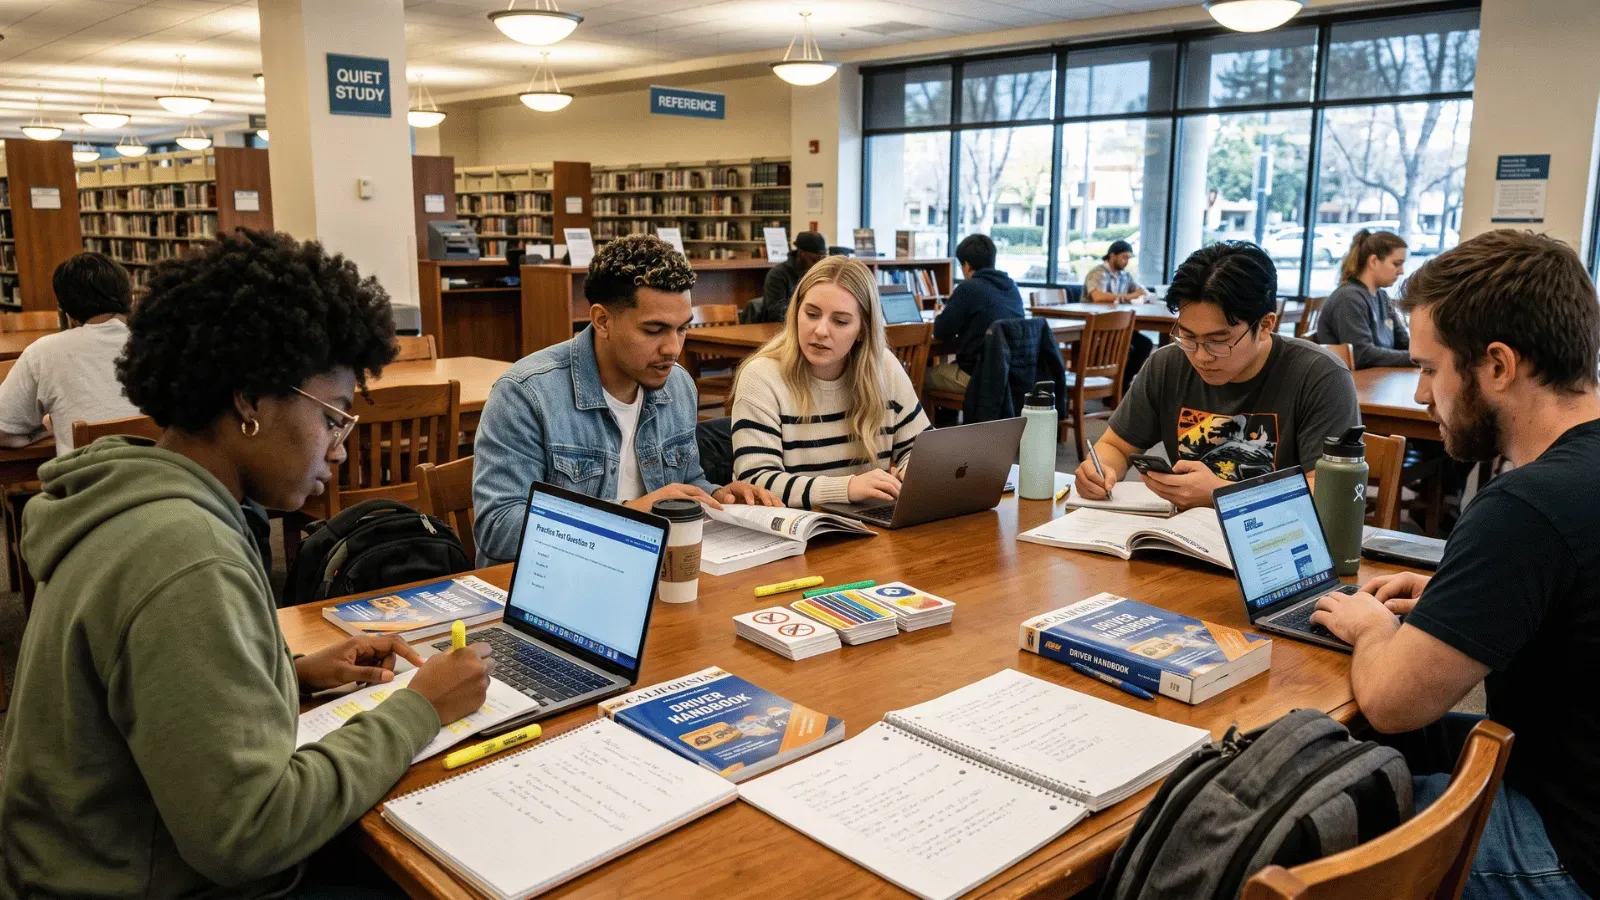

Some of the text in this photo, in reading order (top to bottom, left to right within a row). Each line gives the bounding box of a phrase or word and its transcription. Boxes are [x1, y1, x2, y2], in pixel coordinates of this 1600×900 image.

[336, 68, 382, 85] QUIET
[335, 85, 385, 101] STUDY
[658, 95, 717, 112] REFERENCE
[556, 530, 566, 540] Test
[566, 534, 588, 547] Question
[589, 541, 596, 551] 12
[1044, 599, 1109, 624] CALIFORNIA
[1092, 613, 1138, 631] DRIVER
[1098, 615, 1164, 640] HANDBOOK
[1069, 648, 1130, 675] DRIVER HANDBOOK
[625, 674, 714, 705] CALIFORNIA
[667, 693, 752, 725] HANDBOOK
[668, 691, 726, 713] DRIVER
